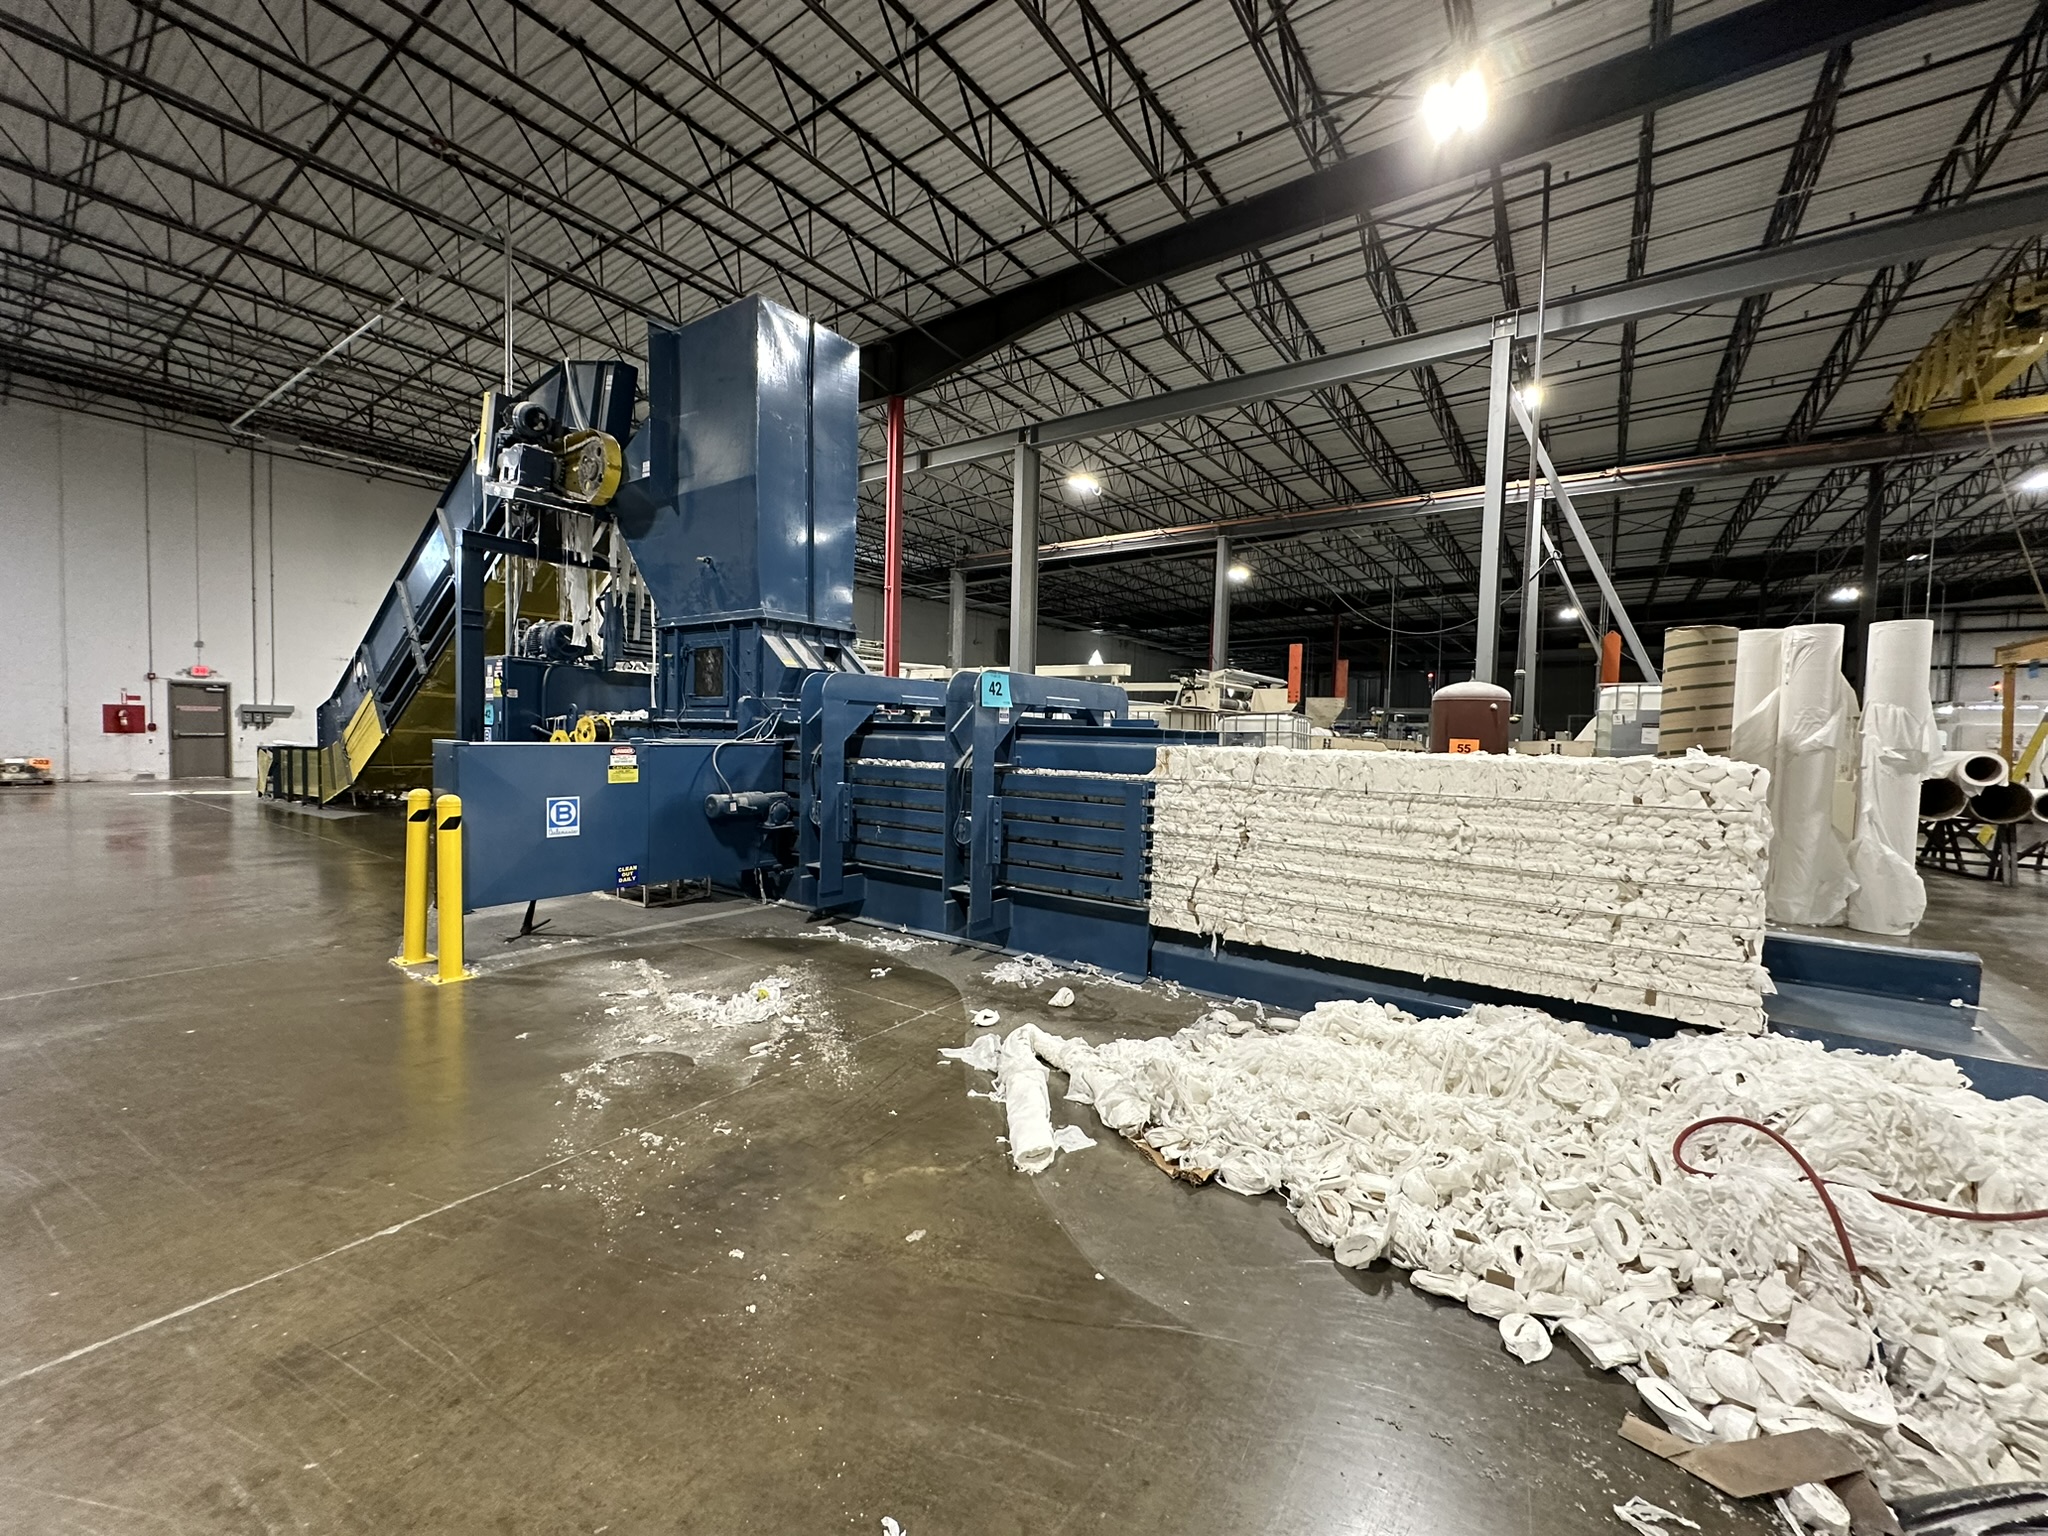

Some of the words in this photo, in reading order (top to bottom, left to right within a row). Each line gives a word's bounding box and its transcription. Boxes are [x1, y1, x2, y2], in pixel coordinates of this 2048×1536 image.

[989, 681, 1003, 696] 42
[1457, 743, 1471, 753] 55
[556, 804, 573, 822] B
[617, 865, 638, 873] CLEAN
[618, 875, 637, 883] DAILY
